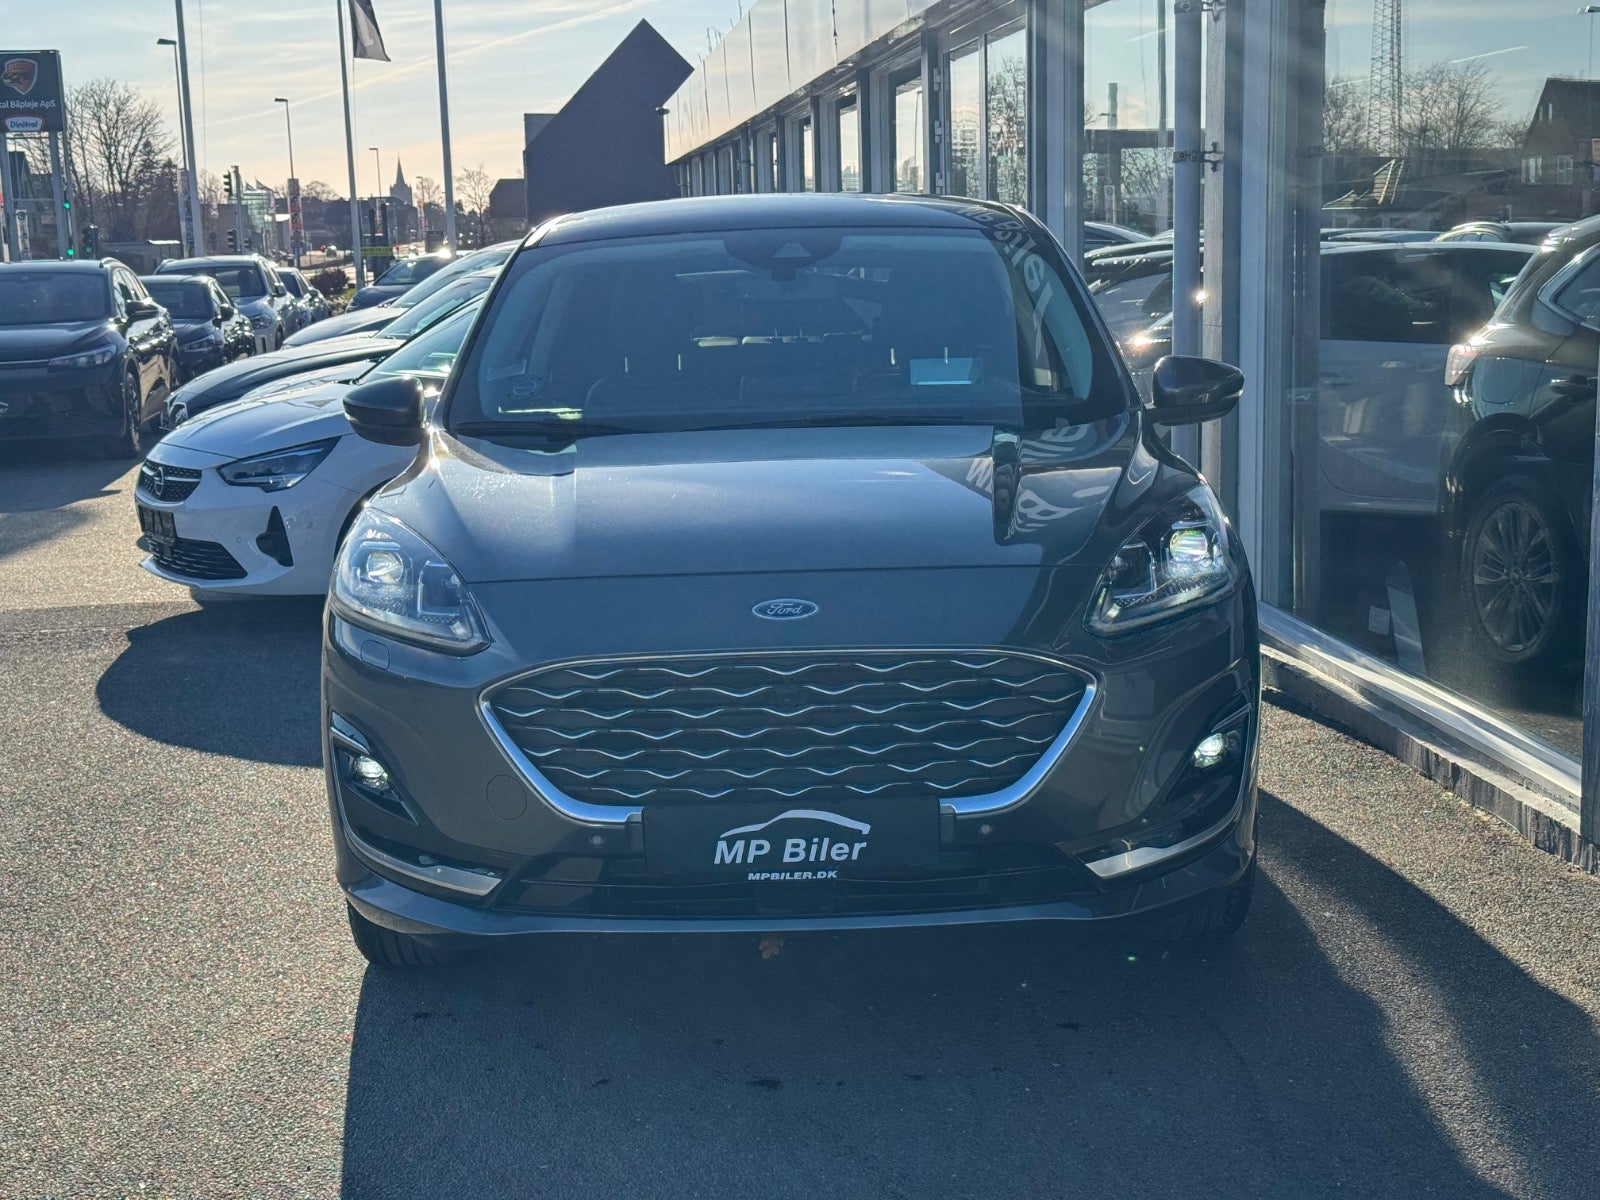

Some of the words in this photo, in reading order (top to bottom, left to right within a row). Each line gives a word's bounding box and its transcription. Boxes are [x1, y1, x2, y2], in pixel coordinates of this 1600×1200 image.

[10, 100, 39, 109] Bilpleje
[40, 99, 56, 109] ApS
[10, 120, 38, 129] Dinitrol
[767, 603, 804, 614] Ford
[714, 839, 770, 864] MP
[782, 838, 867, 863] Biler
[747, 870, 838, 881] MPBILER.DK
